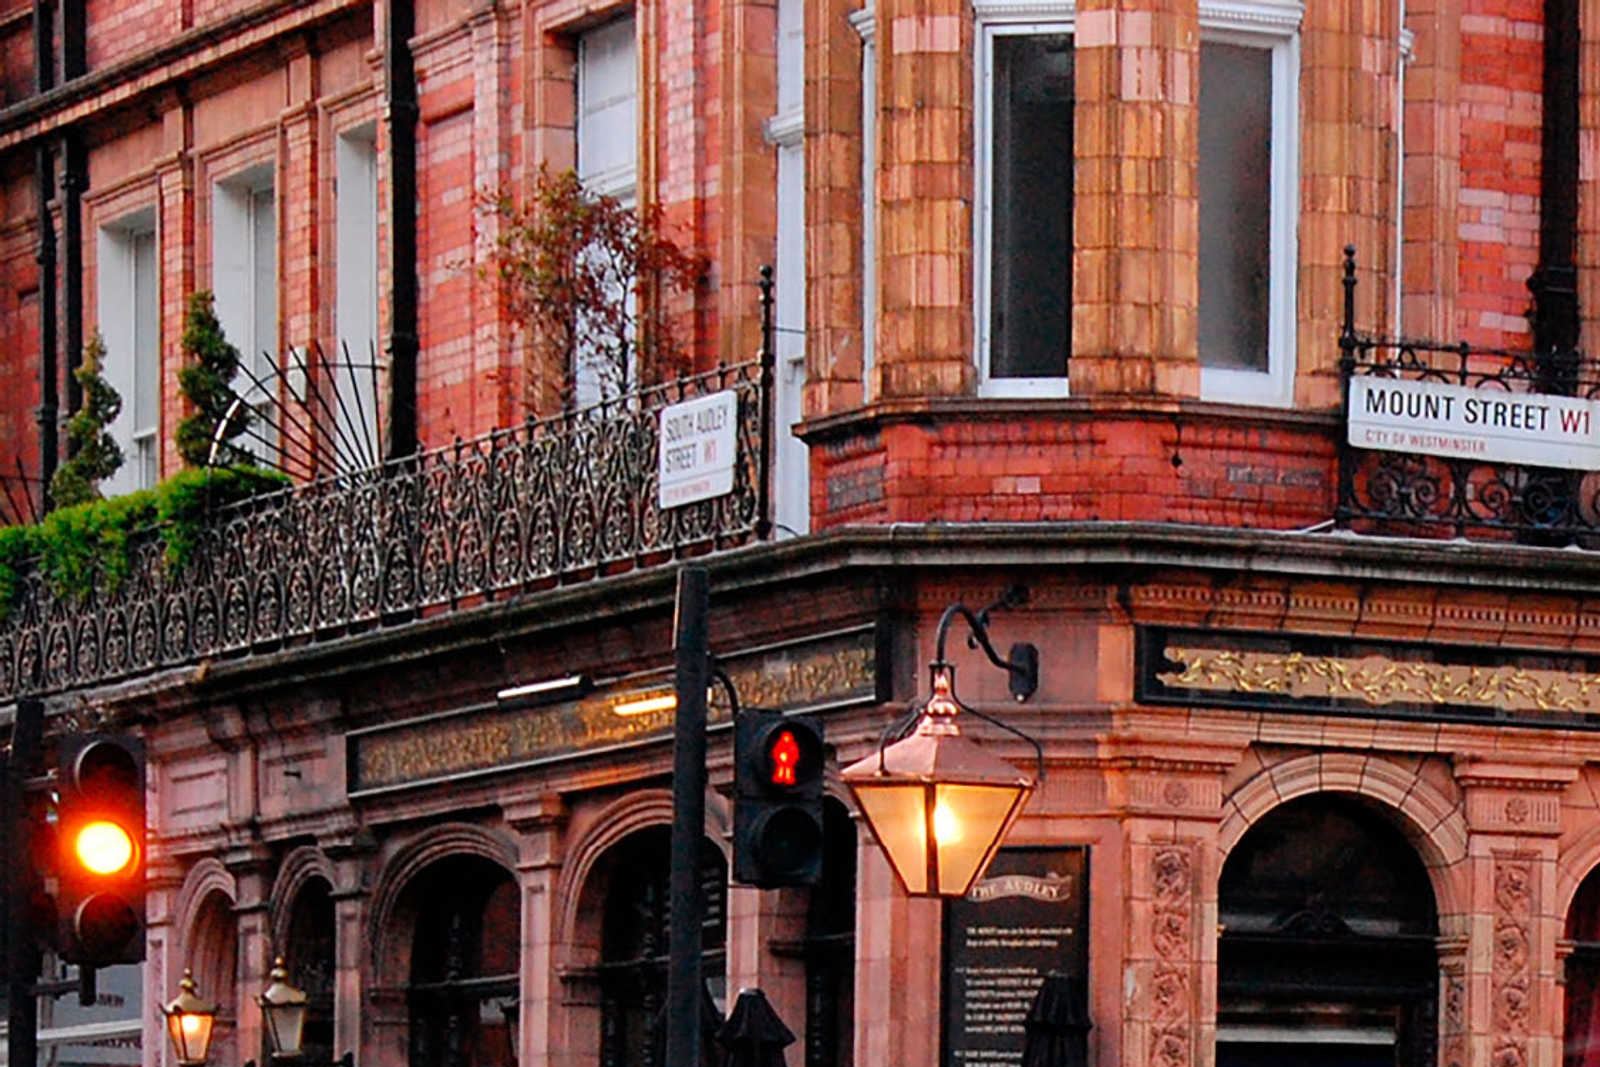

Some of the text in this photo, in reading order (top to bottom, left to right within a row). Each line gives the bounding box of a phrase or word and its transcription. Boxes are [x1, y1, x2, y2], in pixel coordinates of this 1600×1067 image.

[665, 404, 729, 443] SOUTH AUDLEY
[1364, 388, 1591, 435] MOUNT STREET W1
[665, 440, 717, 474] STREET W1
[1365, 429, 1487, 453] CITY OF WESTMINSTER
[971, 880, 1060, 898] THE AUDLEY
